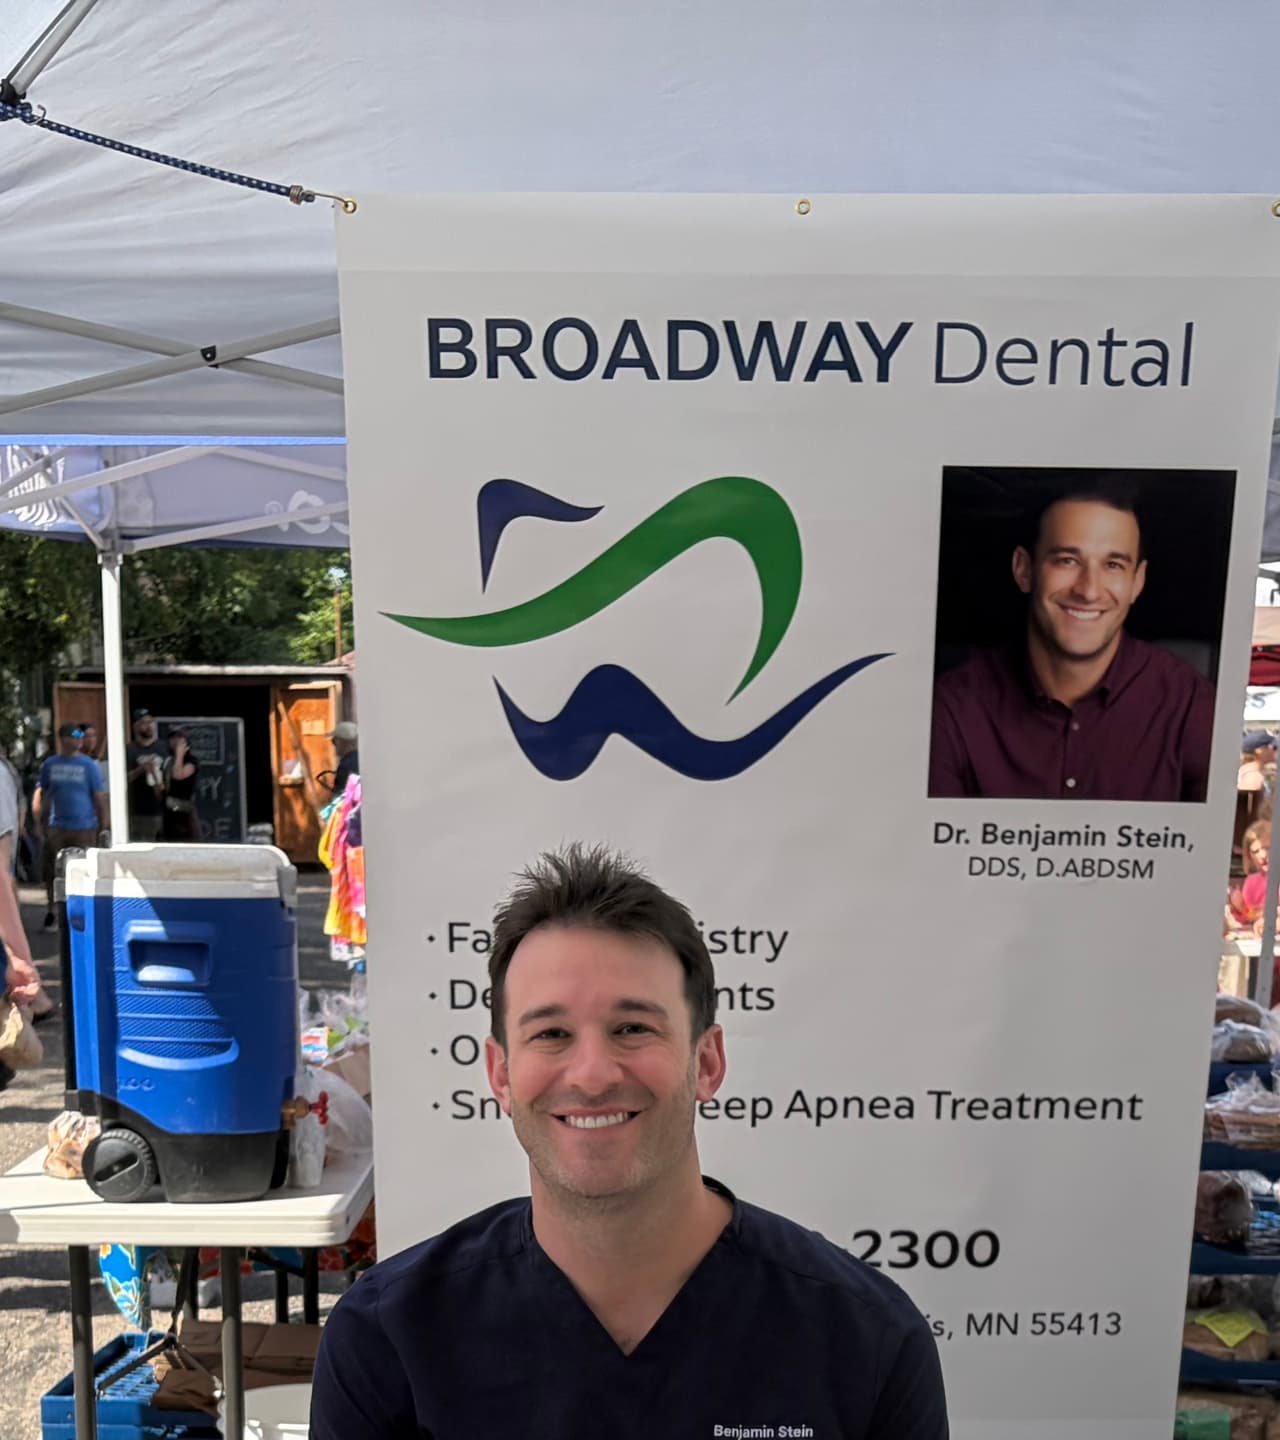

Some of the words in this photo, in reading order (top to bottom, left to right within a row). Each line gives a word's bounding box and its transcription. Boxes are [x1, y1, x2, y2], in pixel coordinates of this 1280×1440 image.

[426, 317, 913, 382] BROADWAY
[934, 321, 1194, 388] Dental
[934, 822, 969, 844] Dr.
[982, 823, 1106, 852] Benjamin
[1117, 825, 1193, 852] Stein,
[969, 856, 1026, 880] DDS,
[1037, 857, 1154, 878] D.ABDSM
[699, 1098, 772, 1127] eep
[784, 1089, 915, 1127] Apnea
[927, 1090, 1144, 1120] Treatment
[966, 1312, 1018, 1336] MN
[1030, 1312, 1121, 1336] 55413
[713, 1424, 774, 1440] Benjamin
[778, 1424, 813, 1437] Stein
